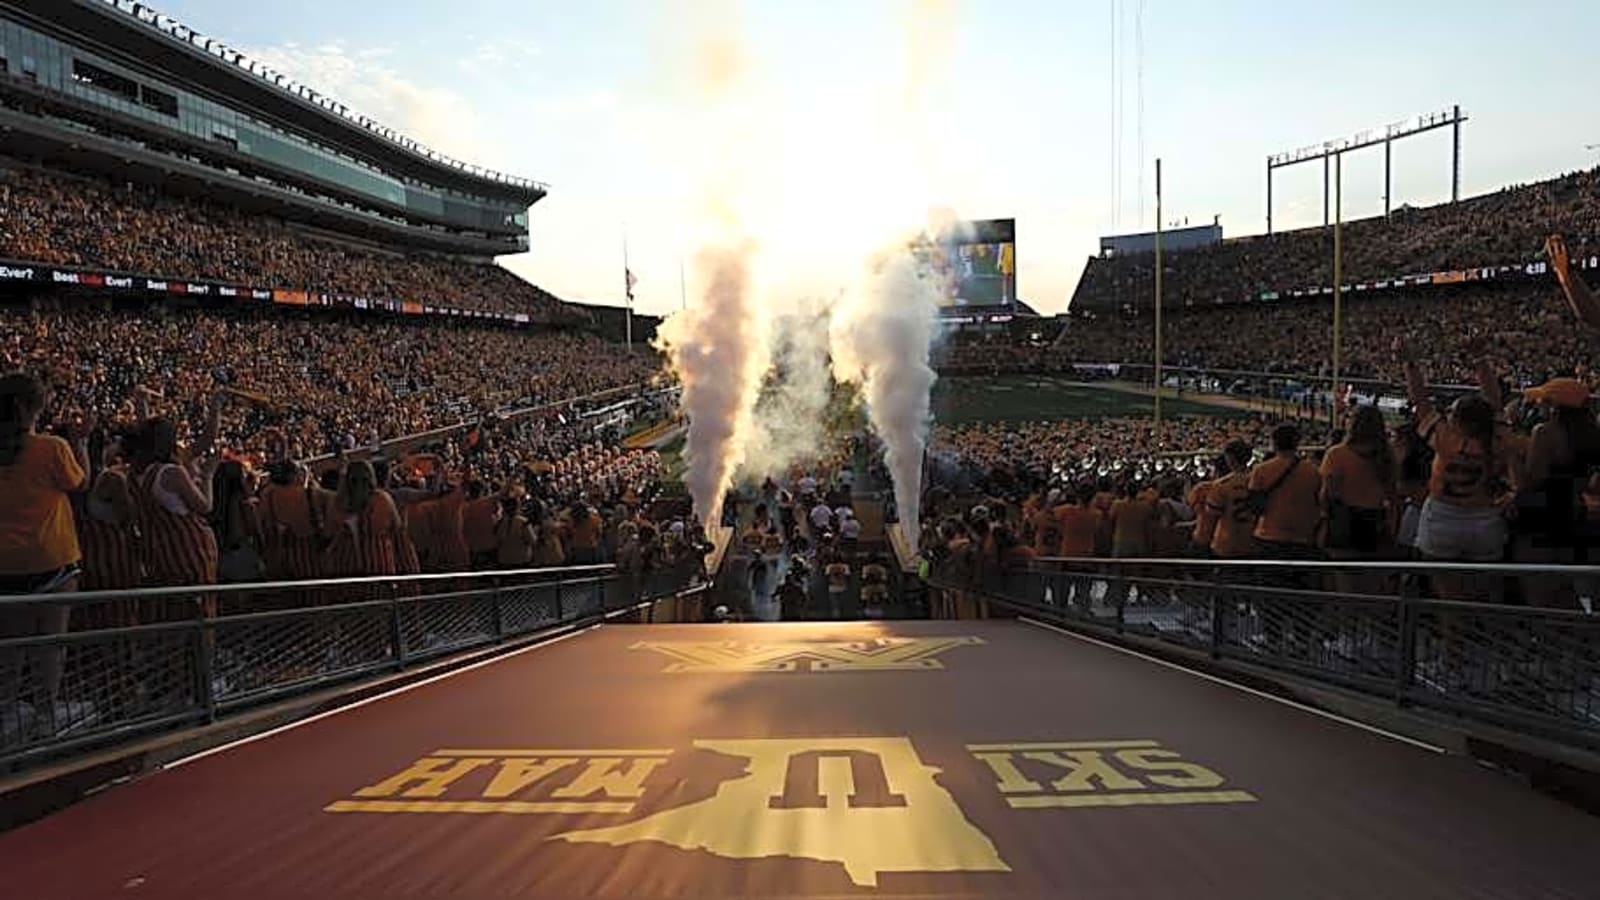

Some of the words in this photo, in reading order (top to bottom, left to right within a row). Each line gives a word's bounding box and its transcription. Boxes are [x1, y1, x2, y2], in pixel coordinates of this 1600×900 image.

[0, 266, 33, 279] Ever?
[53, 271, 80, 283] Best
[105, 276, 132, 288] Ever?
[352, 757, 670, 797] MAH
[768, 749, 908, 809] U
[977, 749, 1224, 793] SKI
